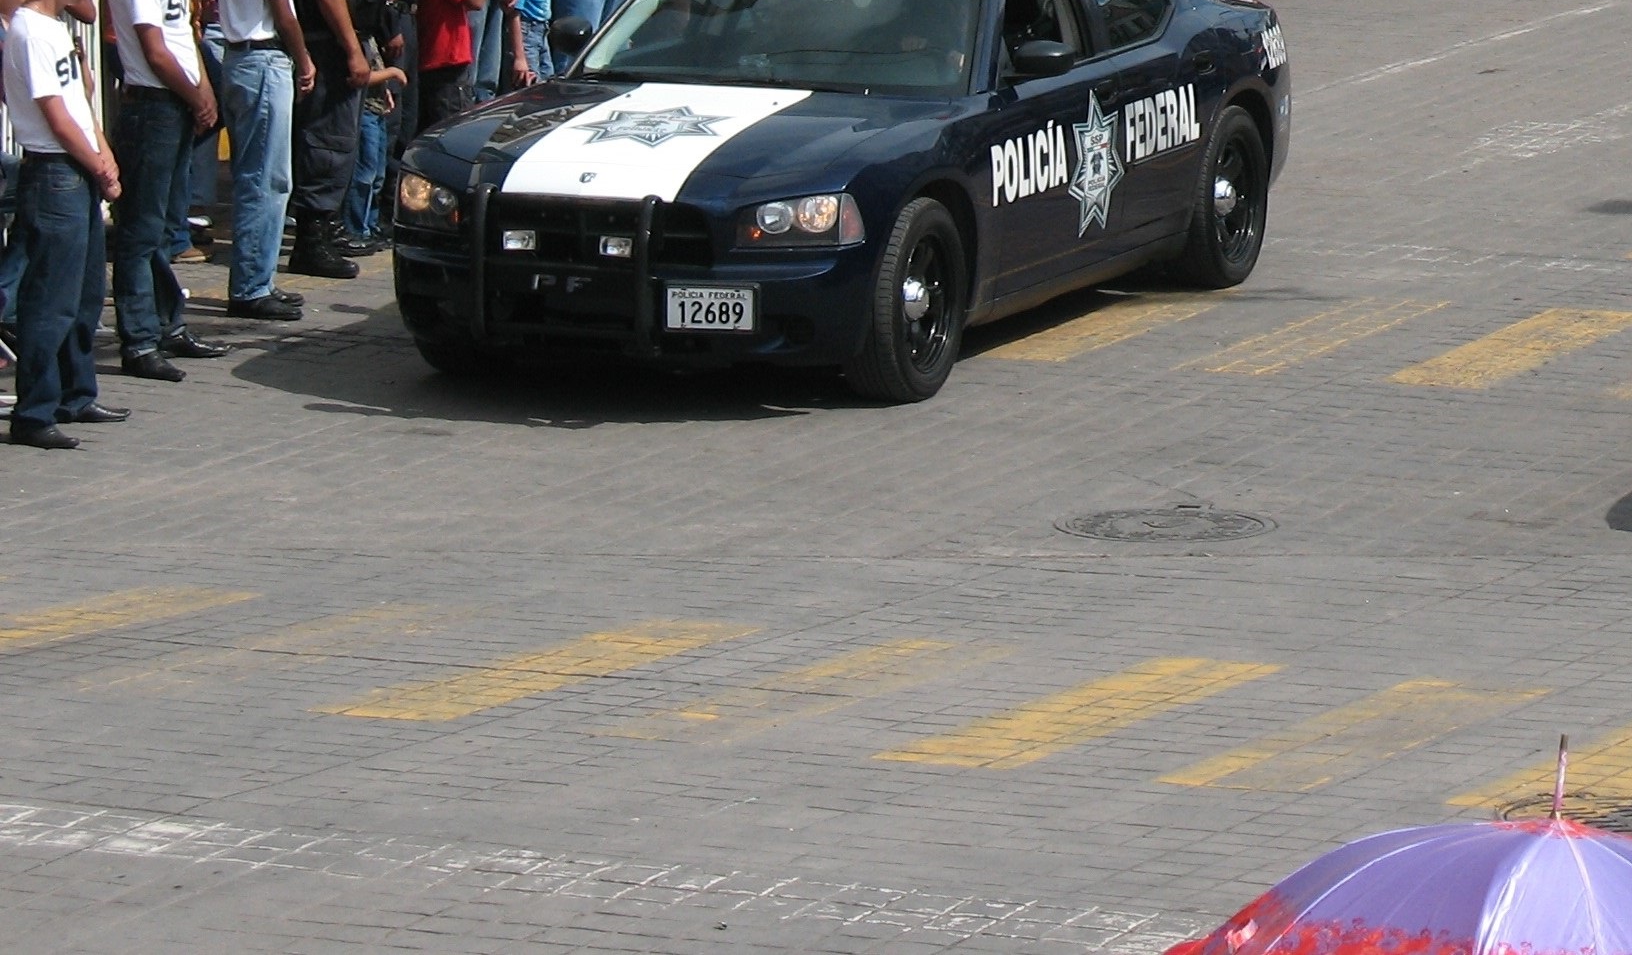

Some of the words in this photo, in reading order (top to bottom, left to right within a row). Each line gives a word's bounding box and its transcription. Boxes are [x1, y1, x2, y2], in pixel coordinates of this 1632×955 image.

[990, 119, 1068, 207] POLICÍA
[1124, 83, 1201, 163] FEDERAL
[1090, 133, 1104, 145] SSP
[708, 291, 748, 300] FEDERAL
[678, 301, 745, 324] 12689
